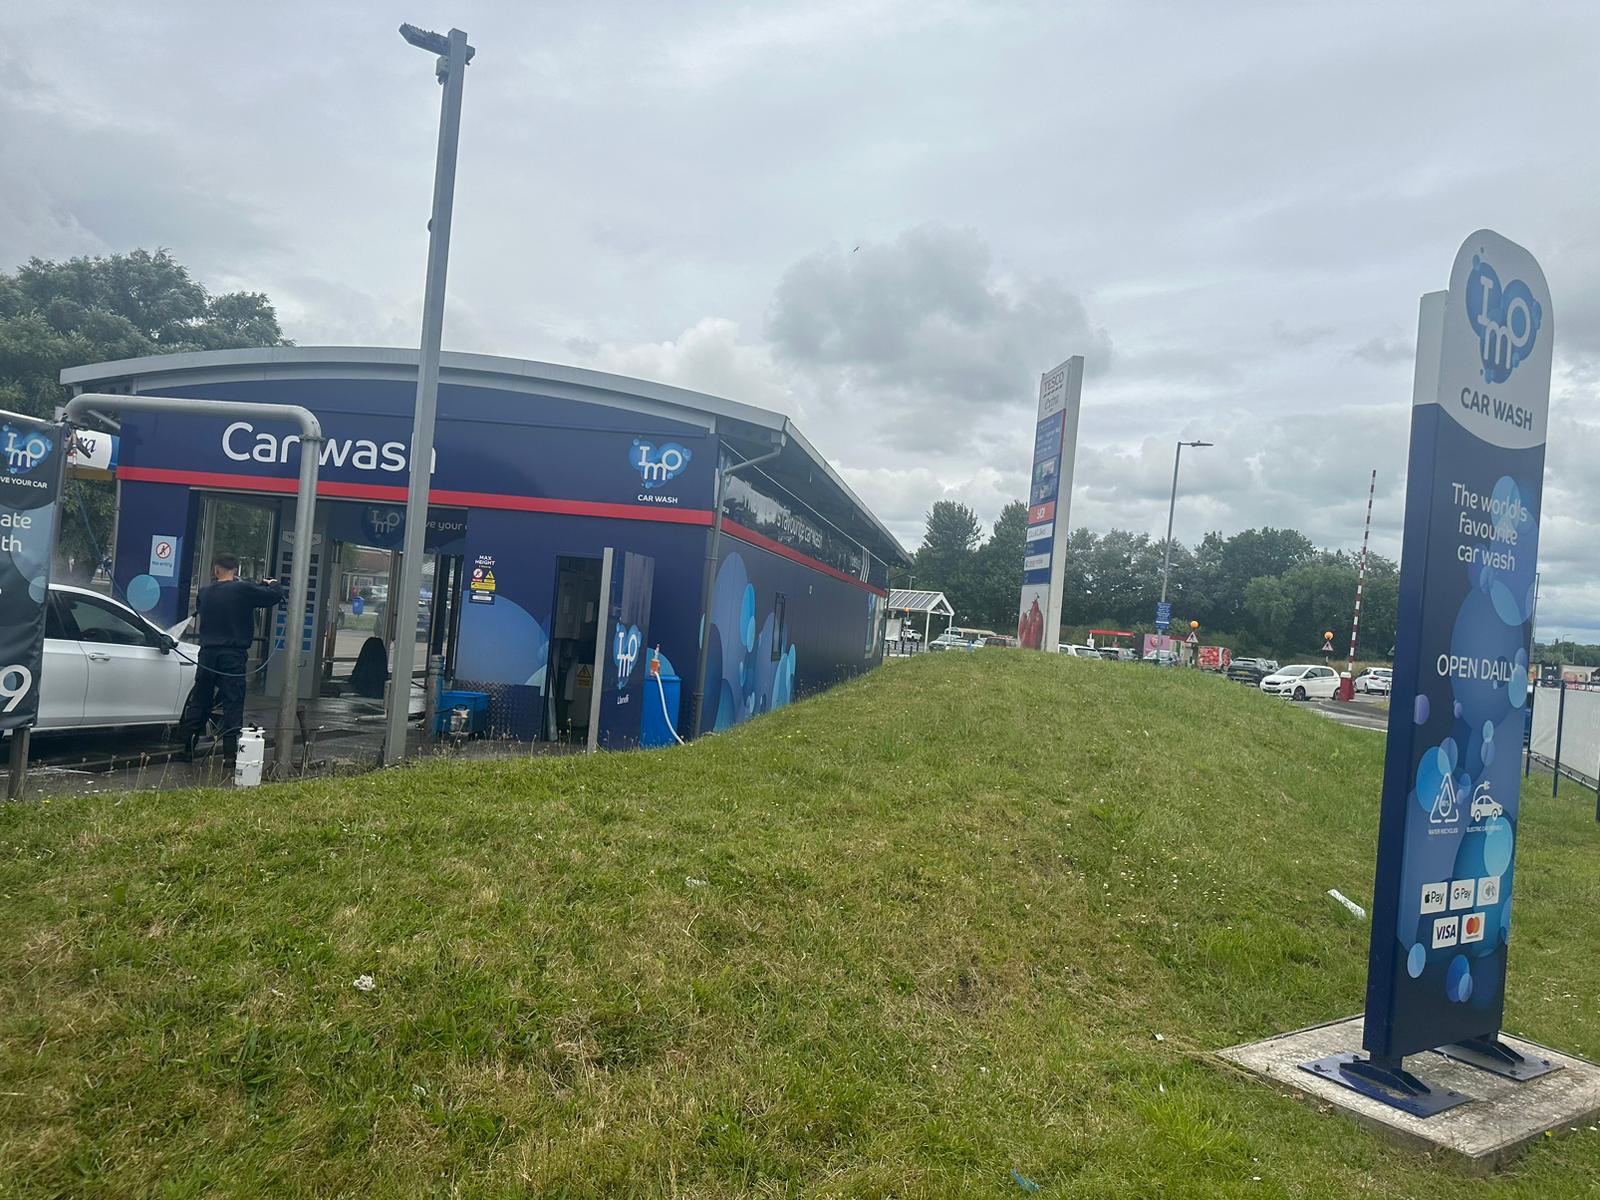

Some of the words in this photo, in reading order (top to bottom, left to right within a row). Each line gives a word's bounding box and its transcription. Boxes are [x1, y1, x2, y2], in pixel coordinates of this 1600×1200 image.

[1461, 387, 1490, 416] CAR
[1493, 399, 1533, 431] WASH
[222, 421, 300, 463] Car
[319, 432, 436, 474] was
[11, 478, 31, 487] YOUR
[33, 481, 48, 489] CAR
[638, 494, 654, 502] CAR
[655, 495, 679, 504] WASH
[1452, 482, 1478, 510] The
[1481, 496, 1528, 522] world's
[438, 521, 463, 532] your
[1459, 512, 1518, 546] favourite
[1457, 544, 1480, 563] car
[1482, 549, 1516, 571] wash
[1436, 653, 1479, 680] OPEN
[1481, 658, 1519, 683] DAILY
[1430, 891, 1444, 904] Pay
[1460, 888, 1472, 900] Pay
[1436, 924, 1457, 941] VISA
